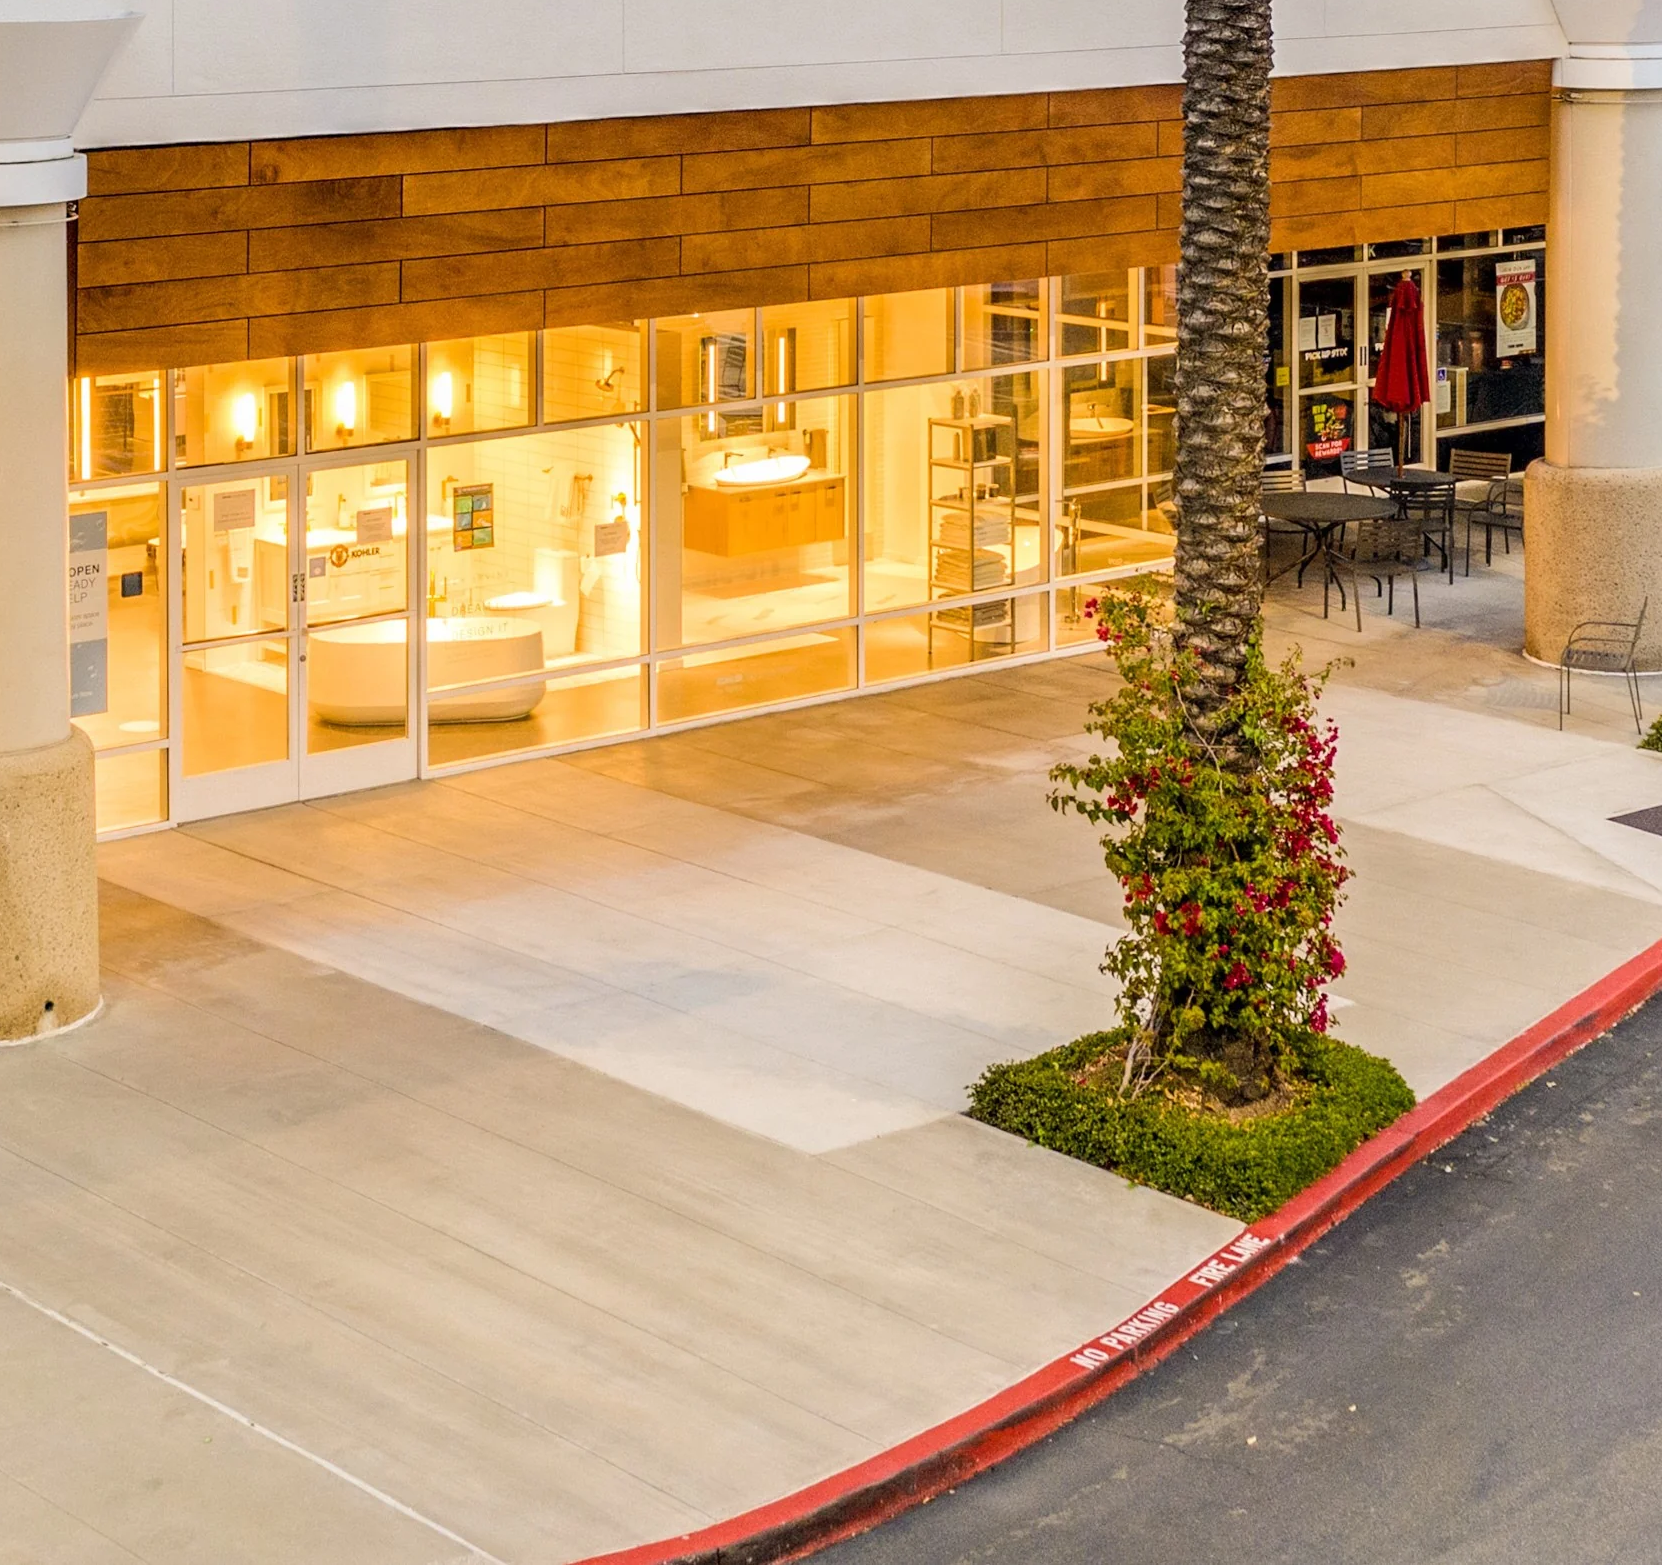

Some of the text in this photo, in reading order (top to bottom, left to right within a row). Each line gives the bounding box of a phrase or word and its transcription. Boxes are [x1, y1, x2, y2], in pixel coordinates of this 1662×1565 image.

[351, 547, 380, 558] KOHLER
[1070, 1232, 1272, 1370] NO PARKING FIRE LANE
